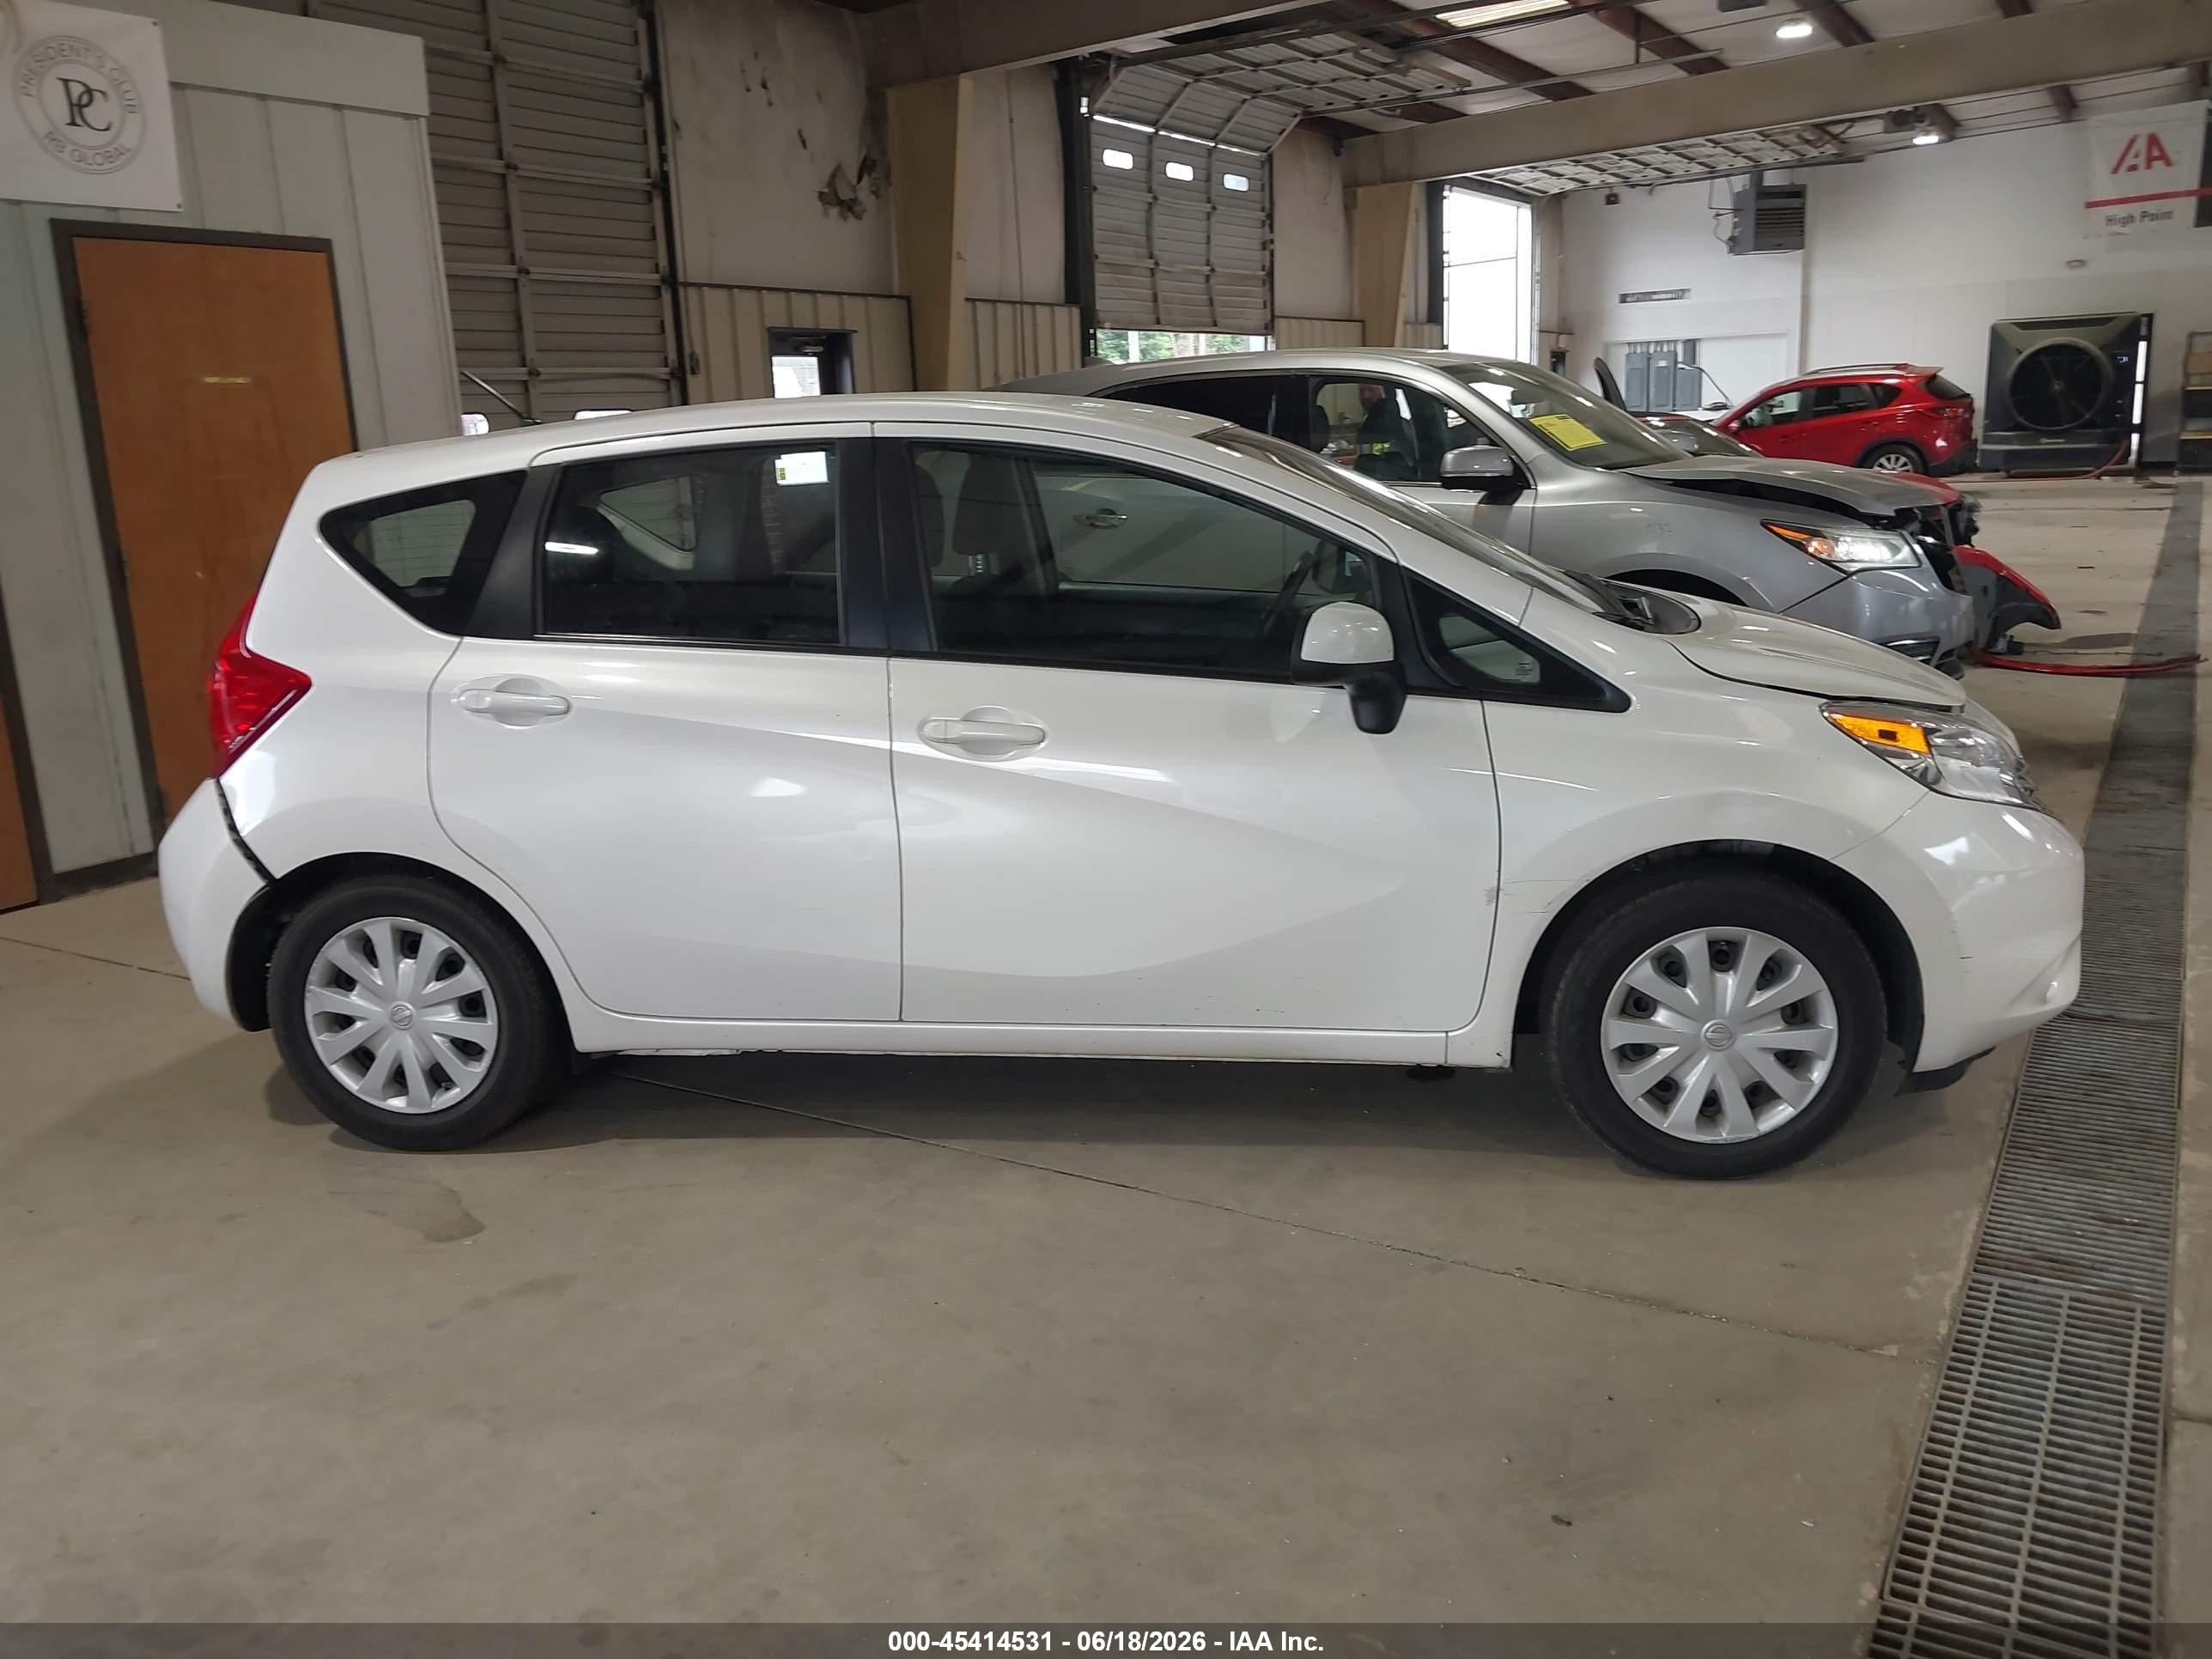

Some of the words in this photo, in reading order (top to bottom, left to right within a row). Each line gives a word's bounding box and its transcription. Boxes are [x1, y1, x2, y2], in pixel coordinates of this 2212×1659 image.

[109, 66, 138, 114] CLUB
[2105, 213, 2136, 228] High
[2139, 210, 2174, 222] Point
